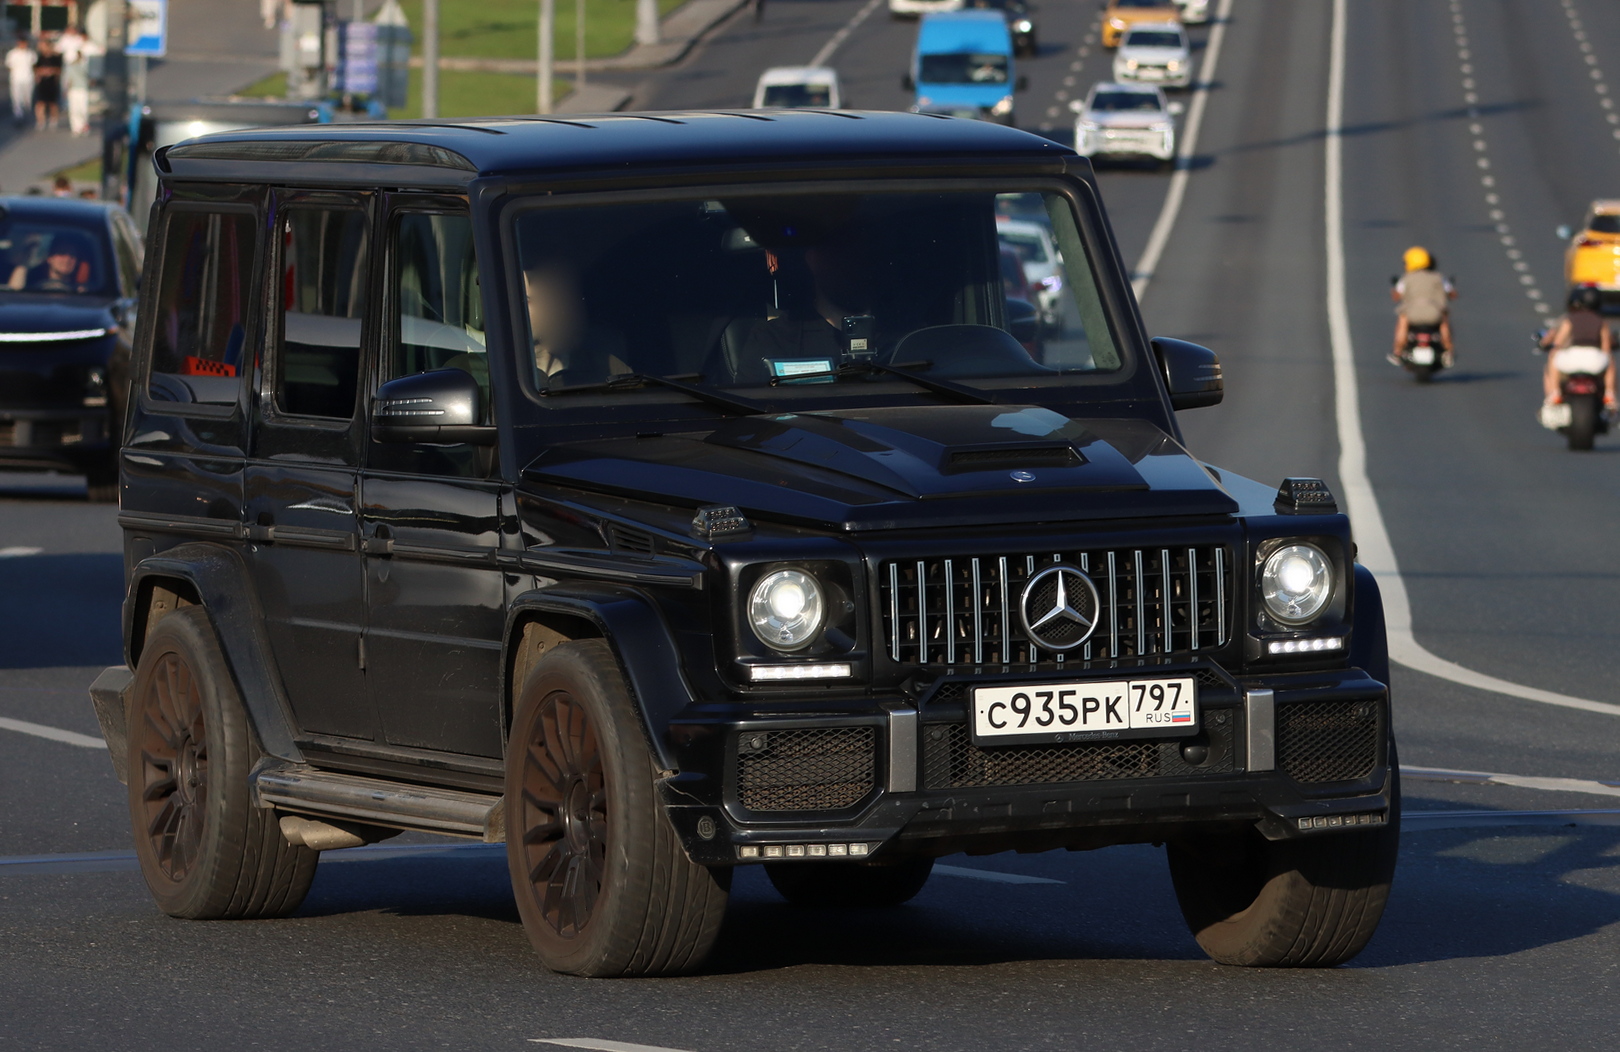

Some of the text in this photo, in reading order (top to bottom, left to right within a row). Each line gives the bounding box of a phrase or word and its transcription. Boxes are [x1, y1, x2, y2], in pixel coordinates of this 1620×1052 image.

[988, 683, 1182, 728] С935РК 797
[1146, 712, 1171, 723] RUS
[1069, 731, 1119, 740] Mercedes-Benz
